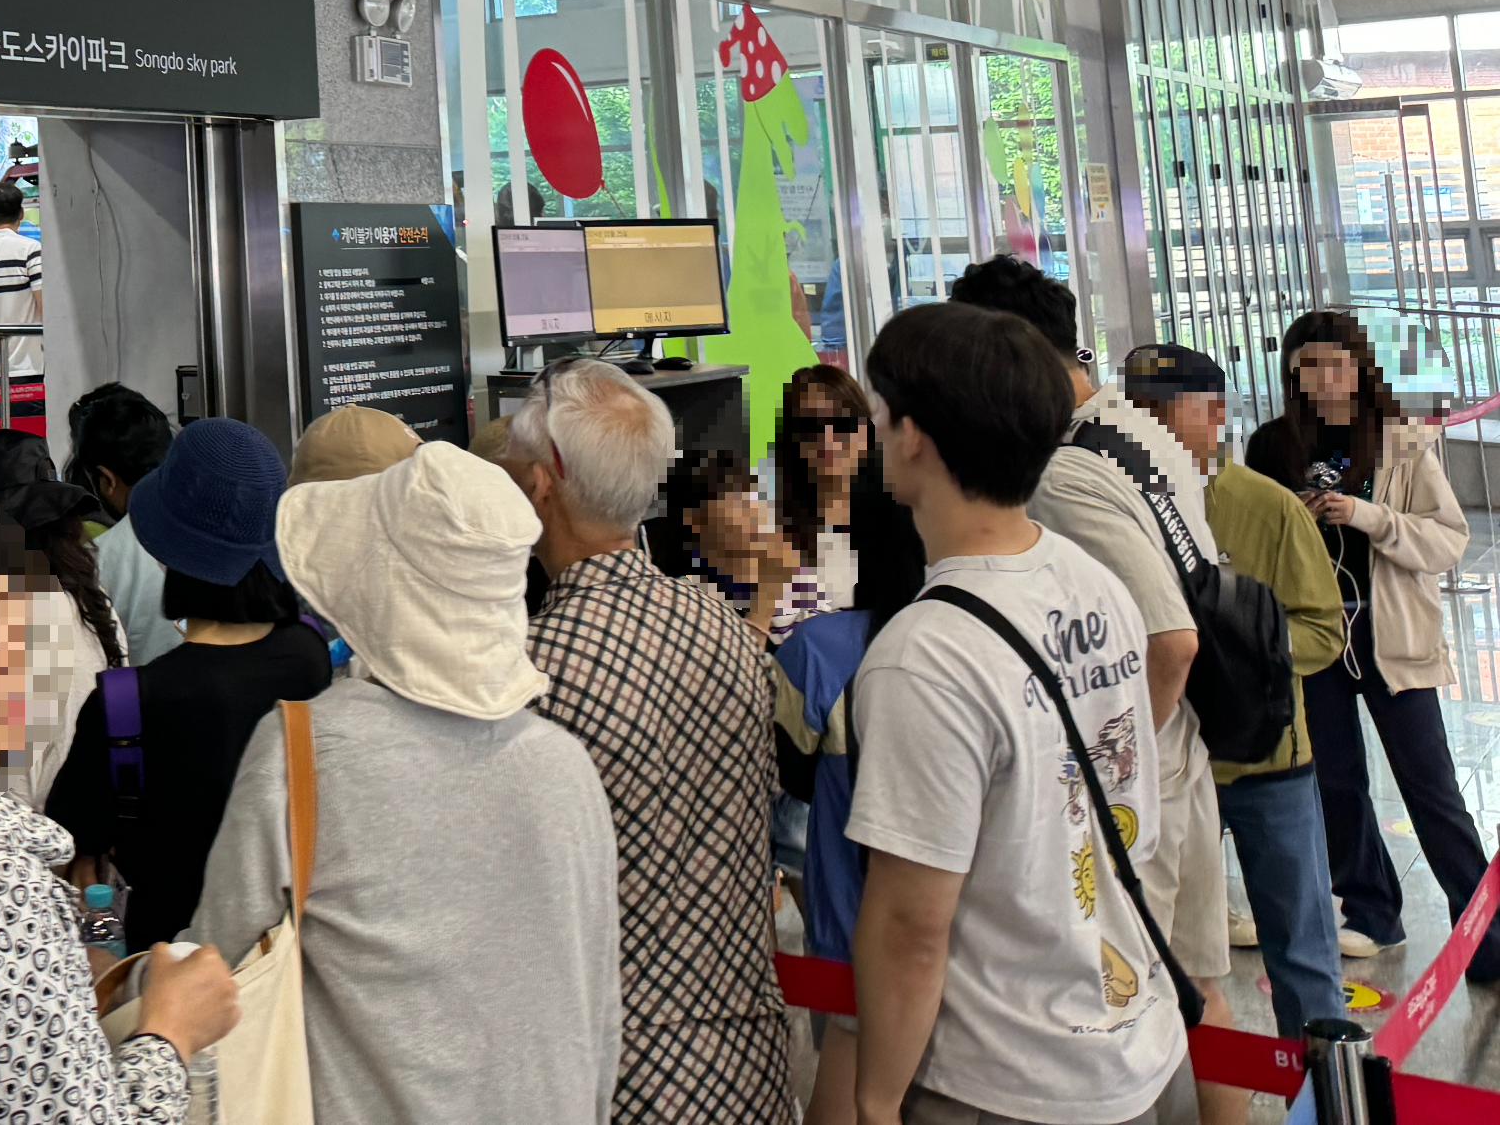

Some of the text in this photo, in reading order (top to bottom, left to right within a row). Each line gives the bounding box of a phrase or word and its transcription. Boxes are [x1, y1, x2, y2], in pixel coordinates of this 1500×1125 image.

[136, 49, 183, 74] Songdo
[187, 54, 207, 76] sky
[211, 57, 237, 77] park
[341, 226, 429, 245] 케이블카 이용자 안전수칙
